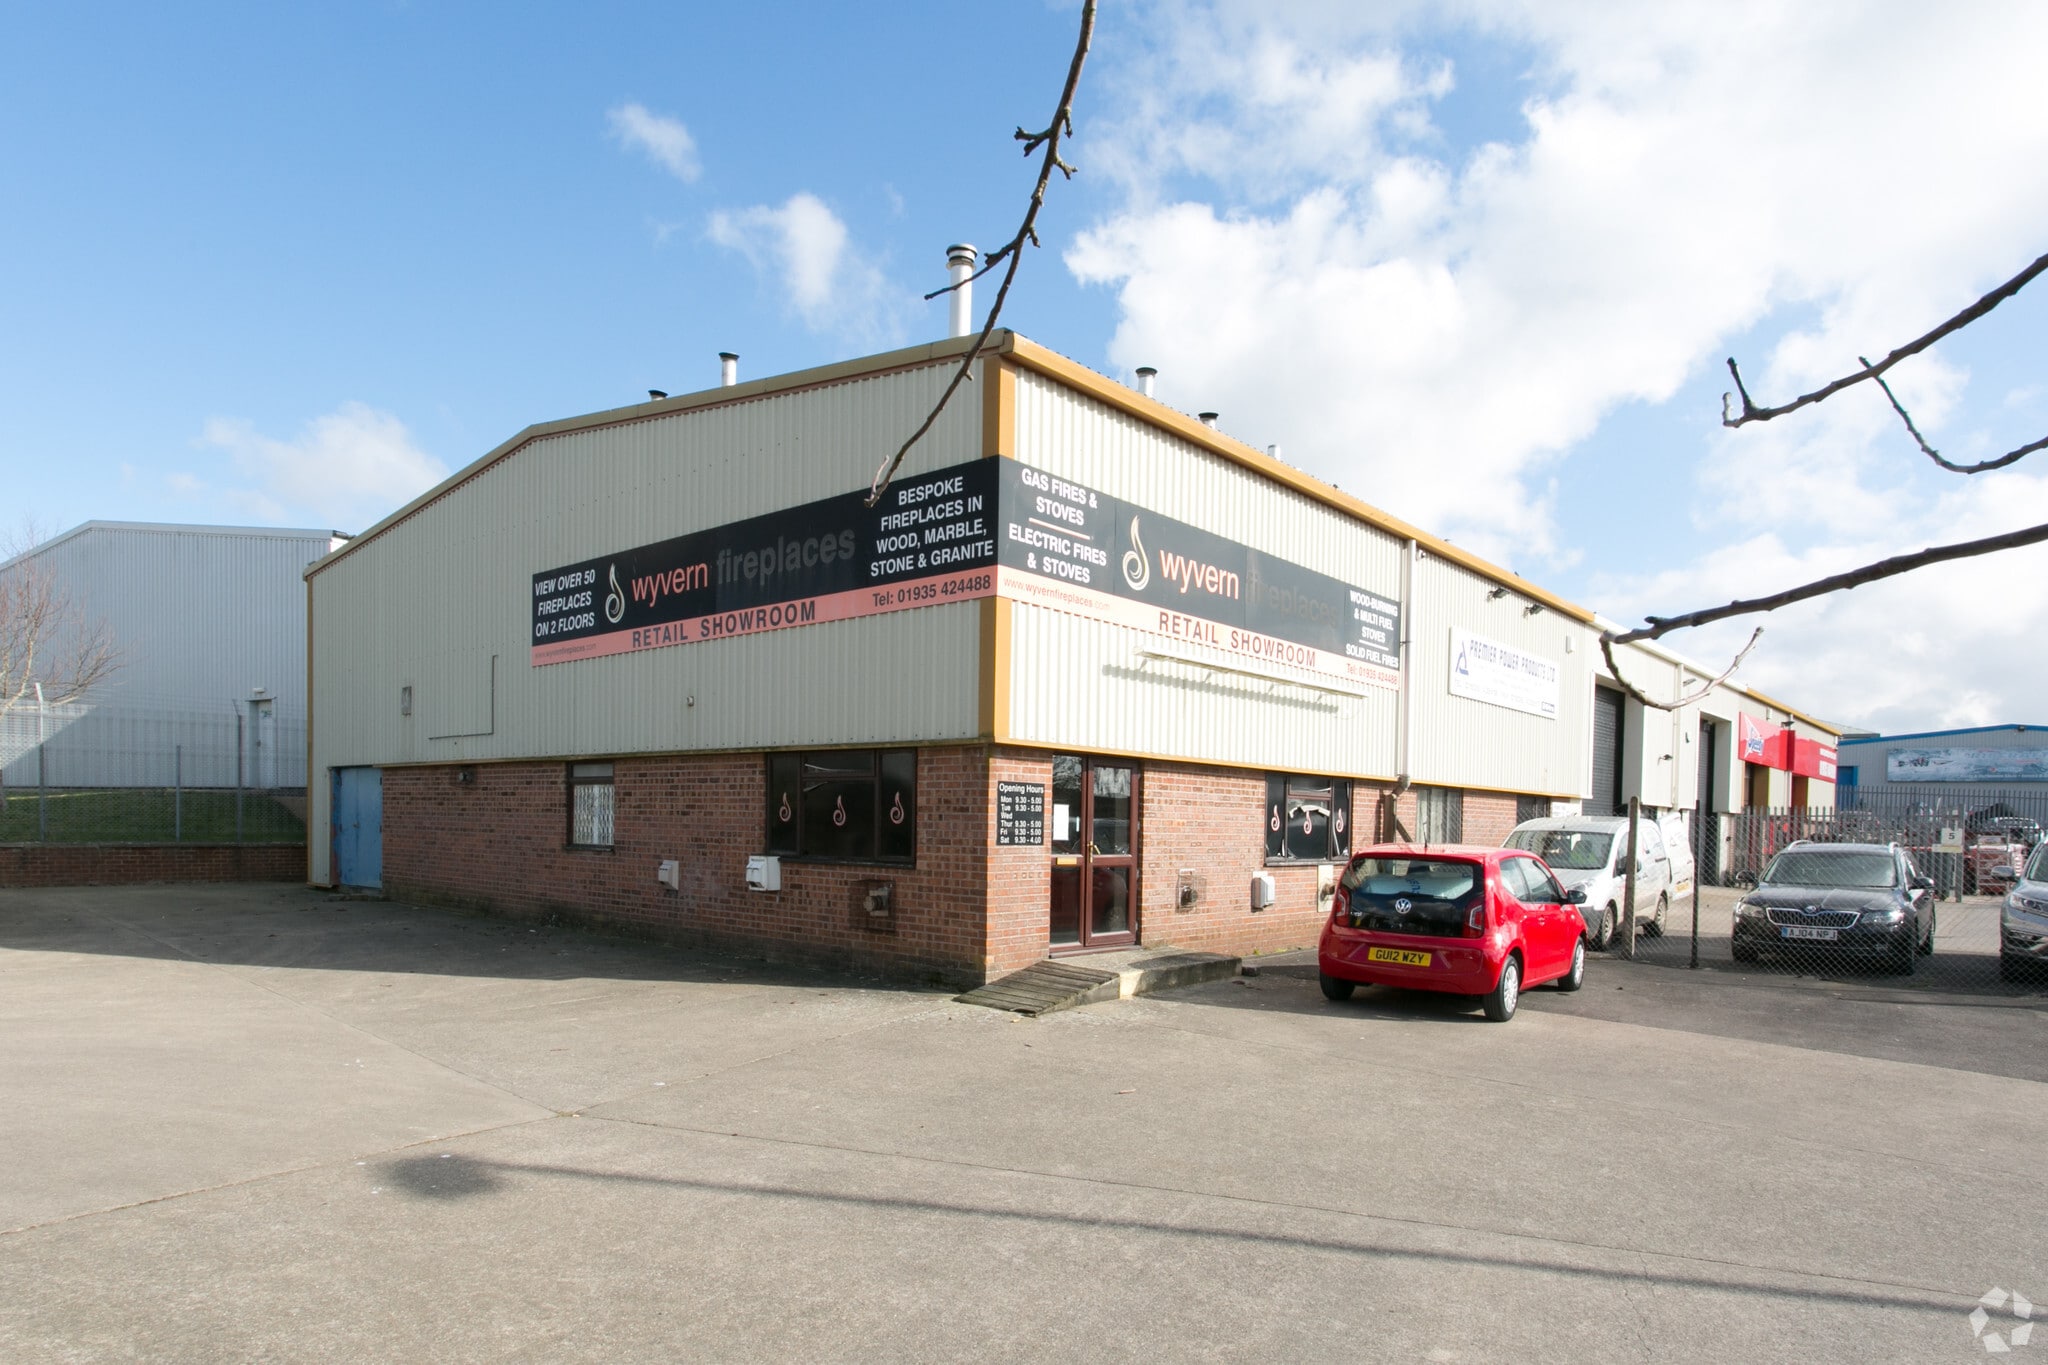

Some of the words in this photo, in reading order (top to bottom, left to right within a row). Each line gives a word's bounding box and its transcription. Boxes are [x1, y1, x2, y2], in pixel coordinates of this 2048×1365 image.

[898, 476, 963, 506] BESPOKE
[1022, 468, 1049, 491] GAS
[1052, 479, 1086, 505] FIRES
[1089, 493, 1097, 509] &
[881, 500, 963, 532] FIREPLACES
[968, 495, 982, 513] IN
[1036, 496, 1084, 526] STOVES
[876, 533, 920, 554] WOOD,
[925, 518, 987, 544] MARBLE,
[1009, 522, 1070, 555] ELECTRIC
[1073, 542, 1107, 566] FIRES
[632, 563, 708, 607] wyvern
[717, 528, 856, 586] fireplaces
[870, 555, 914, 576] STONE
[918, 553, 927, 568] &
[931, 540, 993, 565] GRANITE
[1027, 552, 1036, 569] &
[1043, 556, 1090, 583] STOVES
[535, 579, 555, 596] VIEW
[558, 573, 582, 591] OVER
[584, 569, 596, 584] 50
[1160, 549, 1239, 600] wyvern
[538, 591, 592, 616] FIREPLACES
[872, 592, 893, 607] Tel:
[898, 584, 936, 603] 01935
[941, 575, 990, 596] 424488
[536, 622, 549, 637] ON
[550, 621, 556, 634] 2
[558, 612, 595, 633] FLOORS
[632, 622, 688, 648] RETAIL
[701, 600, 815, 637] SHOWROOM
[1354, 608, 1359, 619] &
[1379, 616, 1394, 630] FUEL
[1159, 612, 1219, 644] RETAIL
[1231, 630, 1316, 667] SHOWROOM
[1362, 626, 1386, 643] STOVES
[1346, 643, 1365, 658] SOLID
[1366, 649, 1381, 664] FUEL
[1382, 654, 1398, 668] FIRES
[999, 783, 1025, 794] Opening
[1026, 784, 1044, 794] Hours
[1948, 832, 1955, 840] 5
[1376, 950, 1400, 961] GU12
[1402, 952, 1424, 964] WZY
